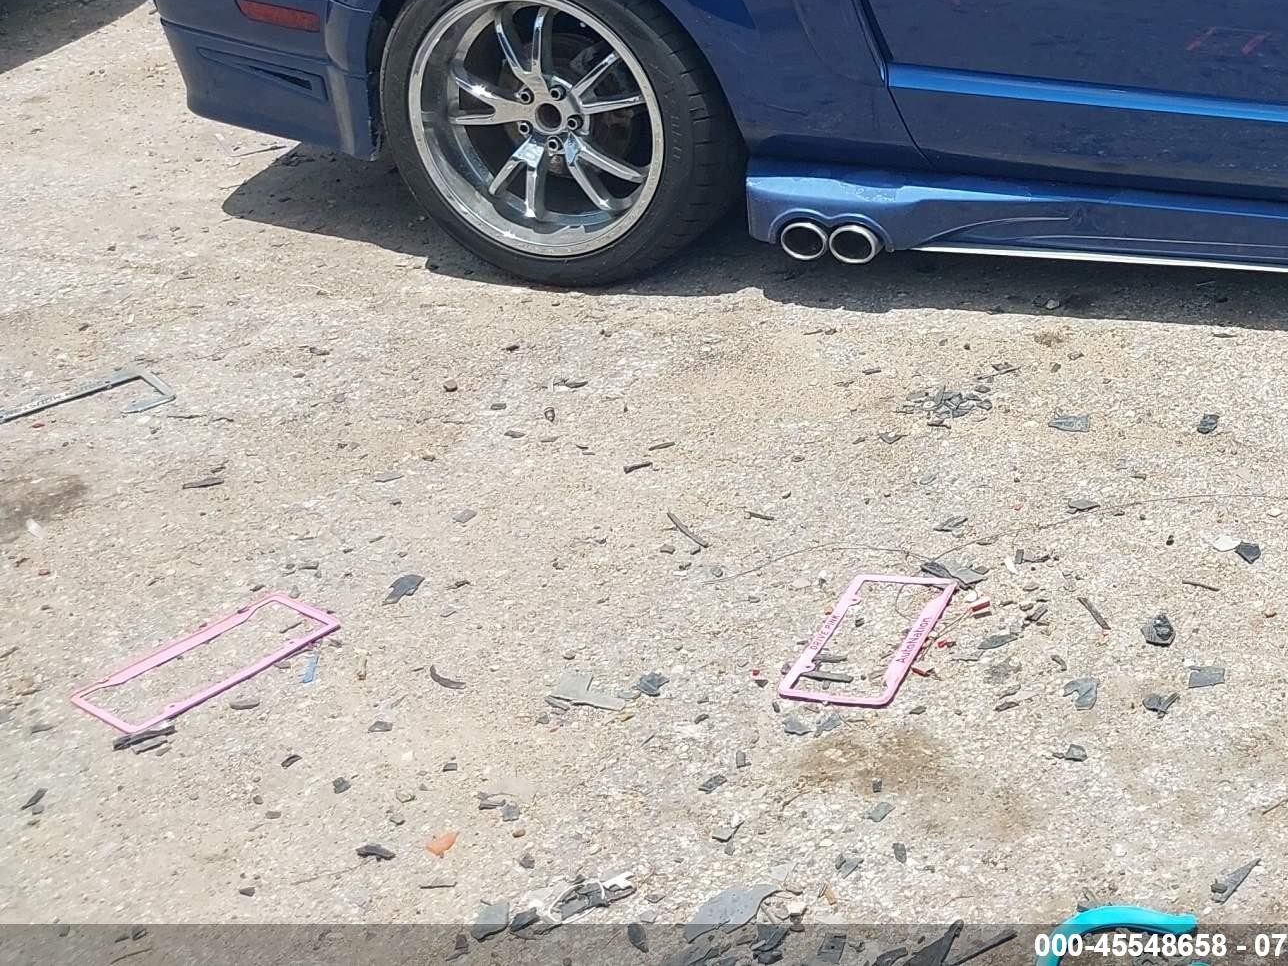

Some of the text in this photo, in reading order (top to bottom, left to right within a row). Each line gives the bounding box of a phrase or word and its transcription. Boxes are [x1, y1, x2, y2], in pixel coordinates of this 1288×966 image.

[810, 613, 841, 651] DRIVE PINK
[895, 616, 932, 664] AutoNation
